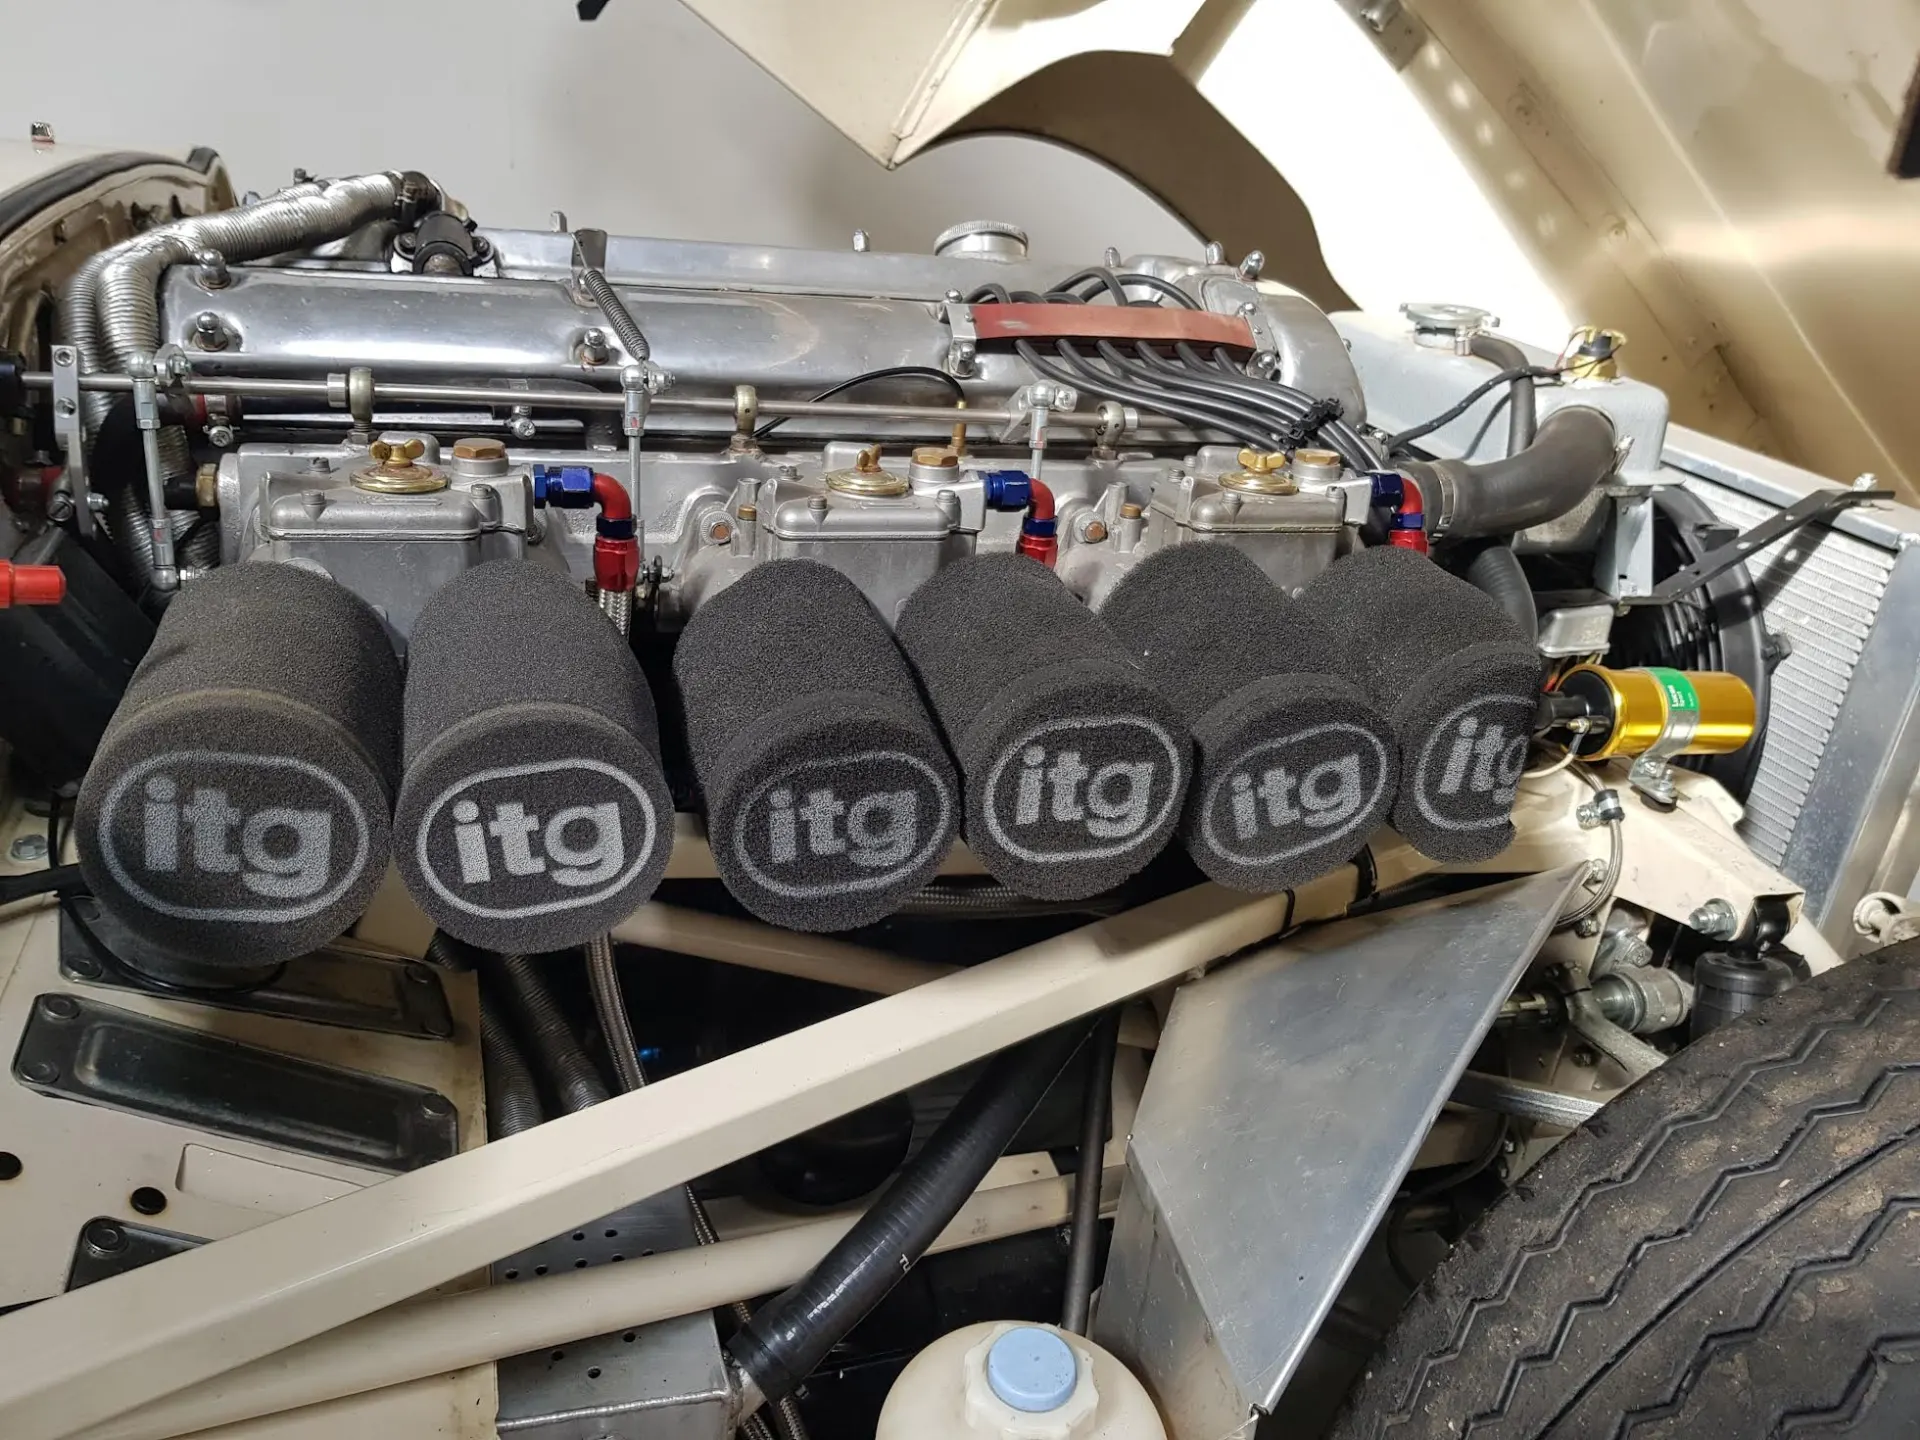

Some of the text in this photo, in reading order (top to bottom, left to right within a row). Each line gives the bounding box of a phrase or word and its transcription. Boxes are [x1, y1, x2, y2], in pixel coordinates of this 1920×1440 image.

[769, 788, 918, 867] itg
[1016, 745, 1154, 838] itg
[1231, 753, 1361, 841] itg
[144, 775, 332, 898] itg
[452, 799, 626, 887] itg
